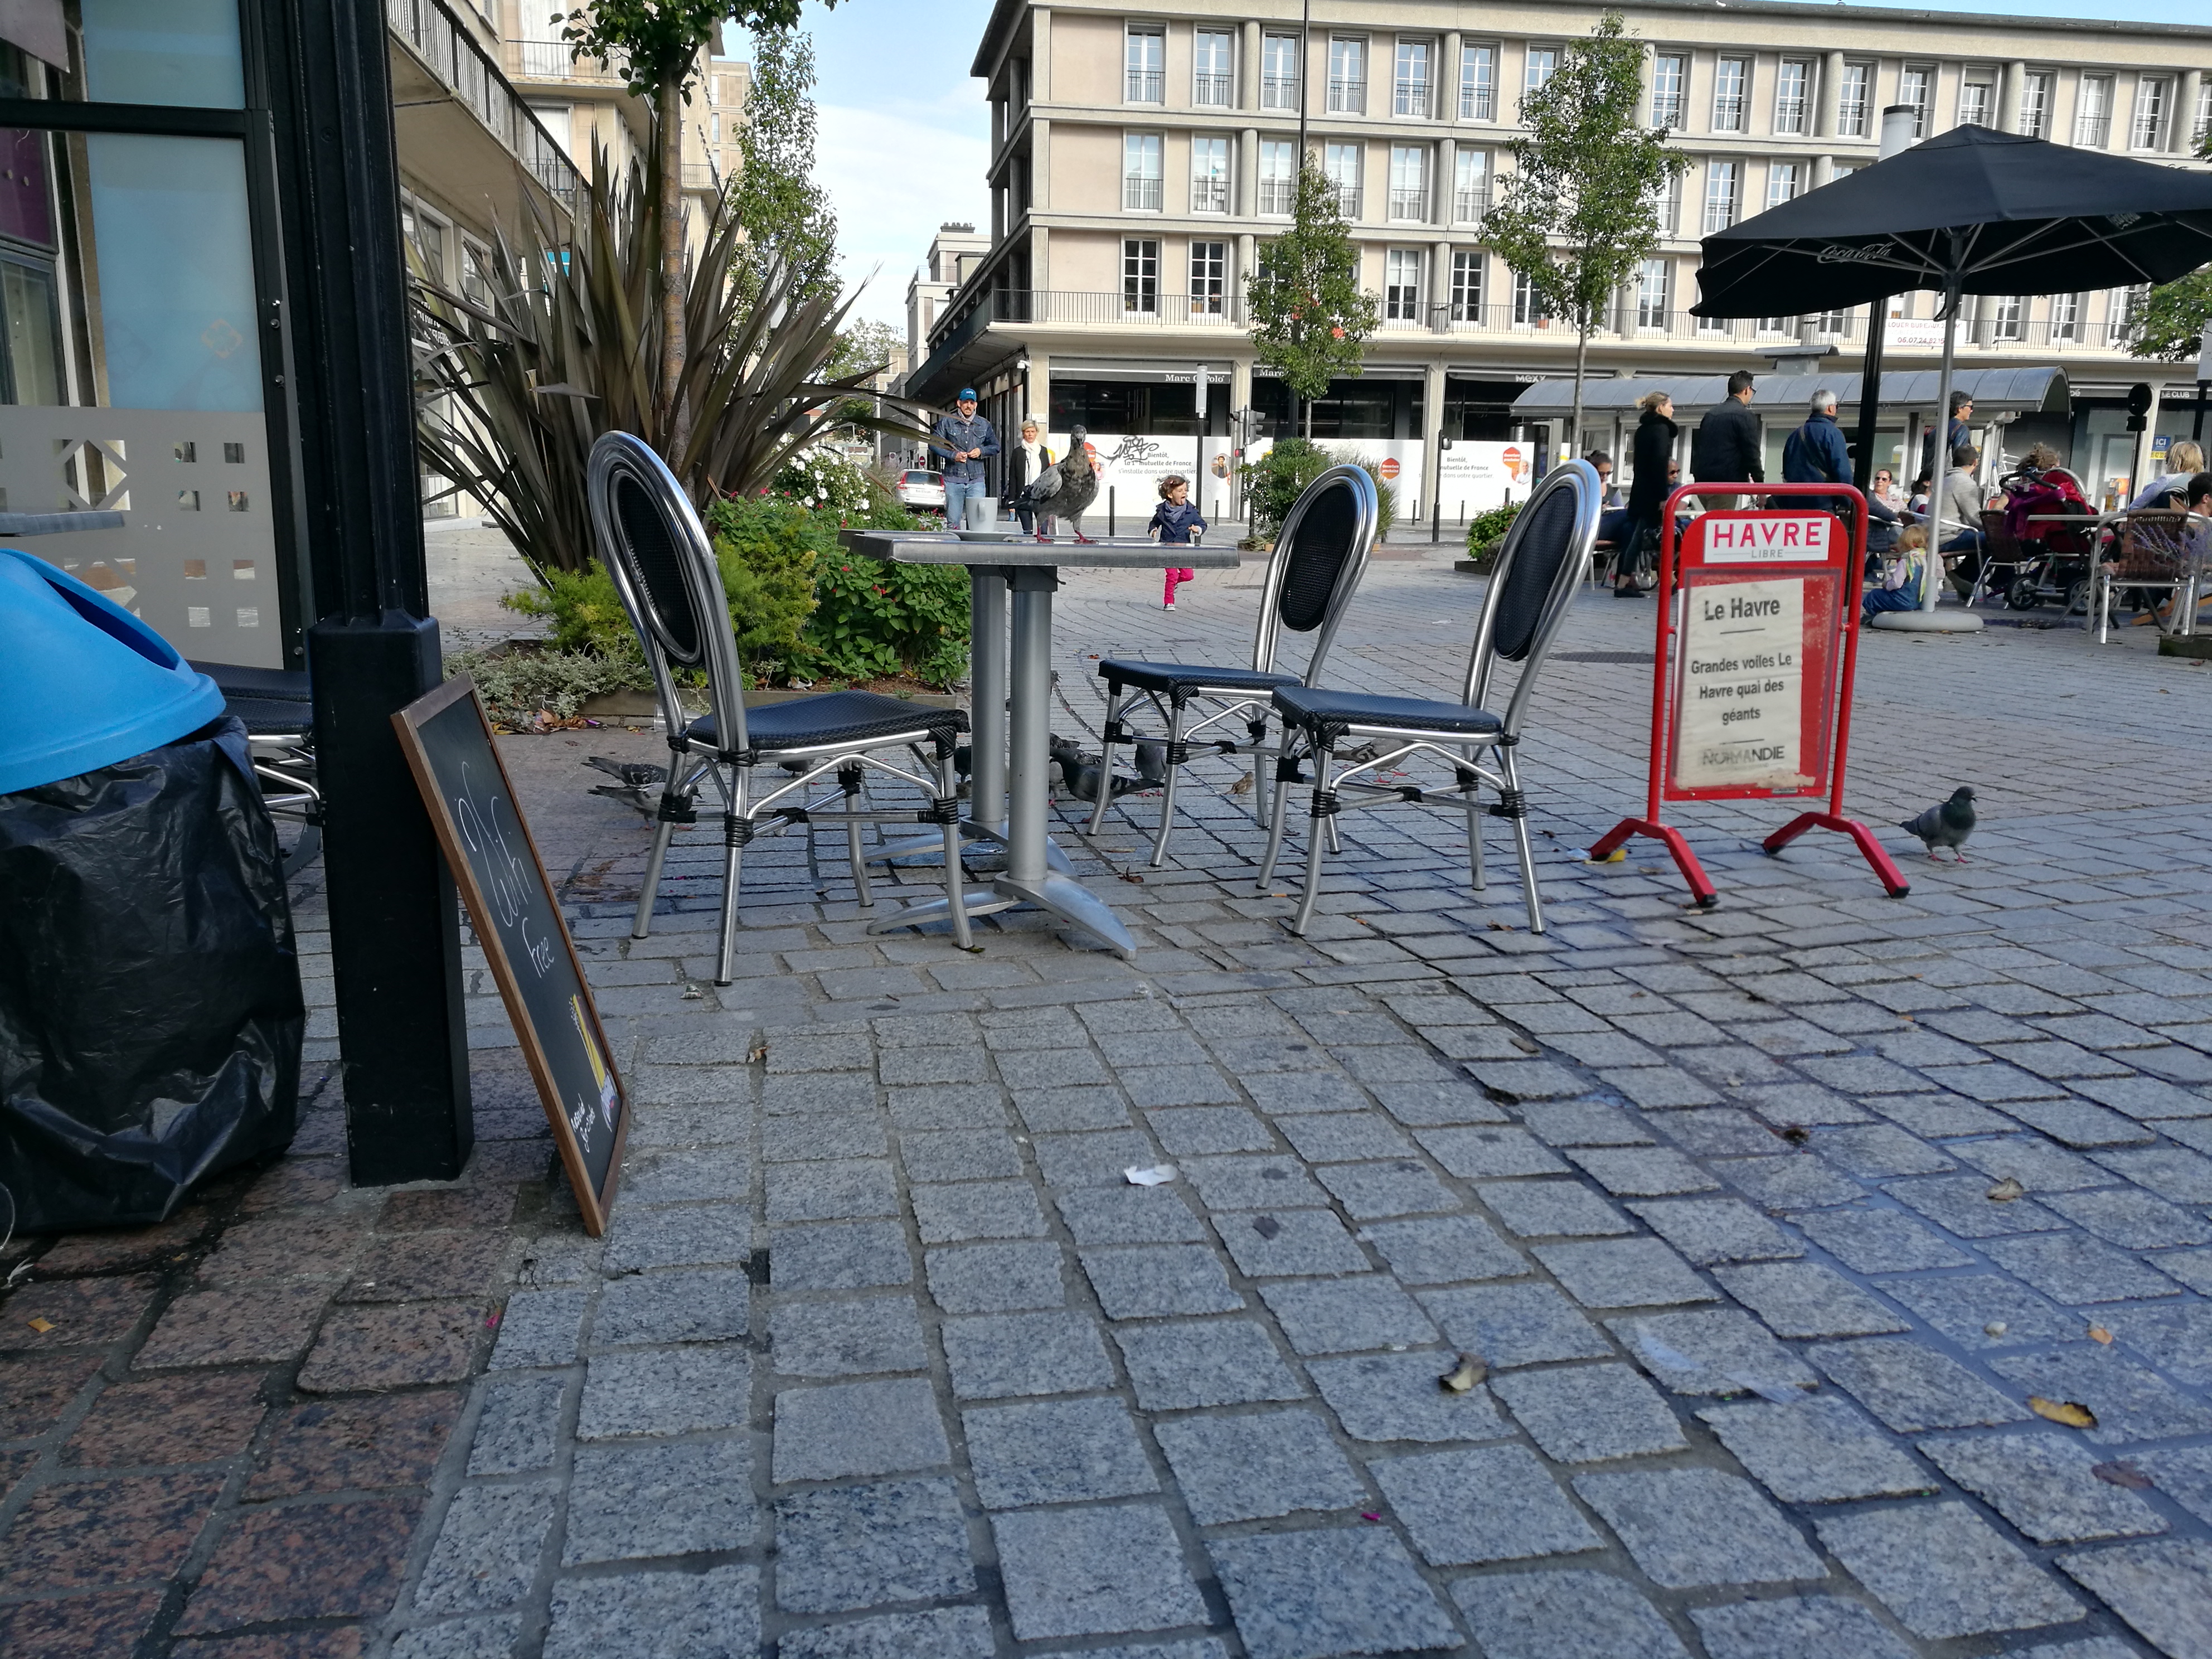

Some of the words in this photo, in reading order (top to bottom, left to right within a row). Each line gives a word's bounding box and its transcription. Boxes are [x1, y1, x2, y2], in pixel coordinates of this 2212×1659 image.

[1259, 368, 1284, 377] Marc
[1713, 522, 1823, 548] HAVRE
[1751, 549, 1784, 558] LIBRE
[1704, 600, 1725, 621] Le
[1730, 596, 1781, 619] Havre
[1691, 658, 1739, 675] Grandes
[1742, 654, 1774, 671] voiles
[1778, 653, 1792, 667] Le
[1699, 685, 1733, 700] Havre
[1737, 681, 1761, 699] quai
[1764, 679, 1784, 693] des
[1722, 706, 1761, 726] géants
[522, 916, 555, 978] Free
